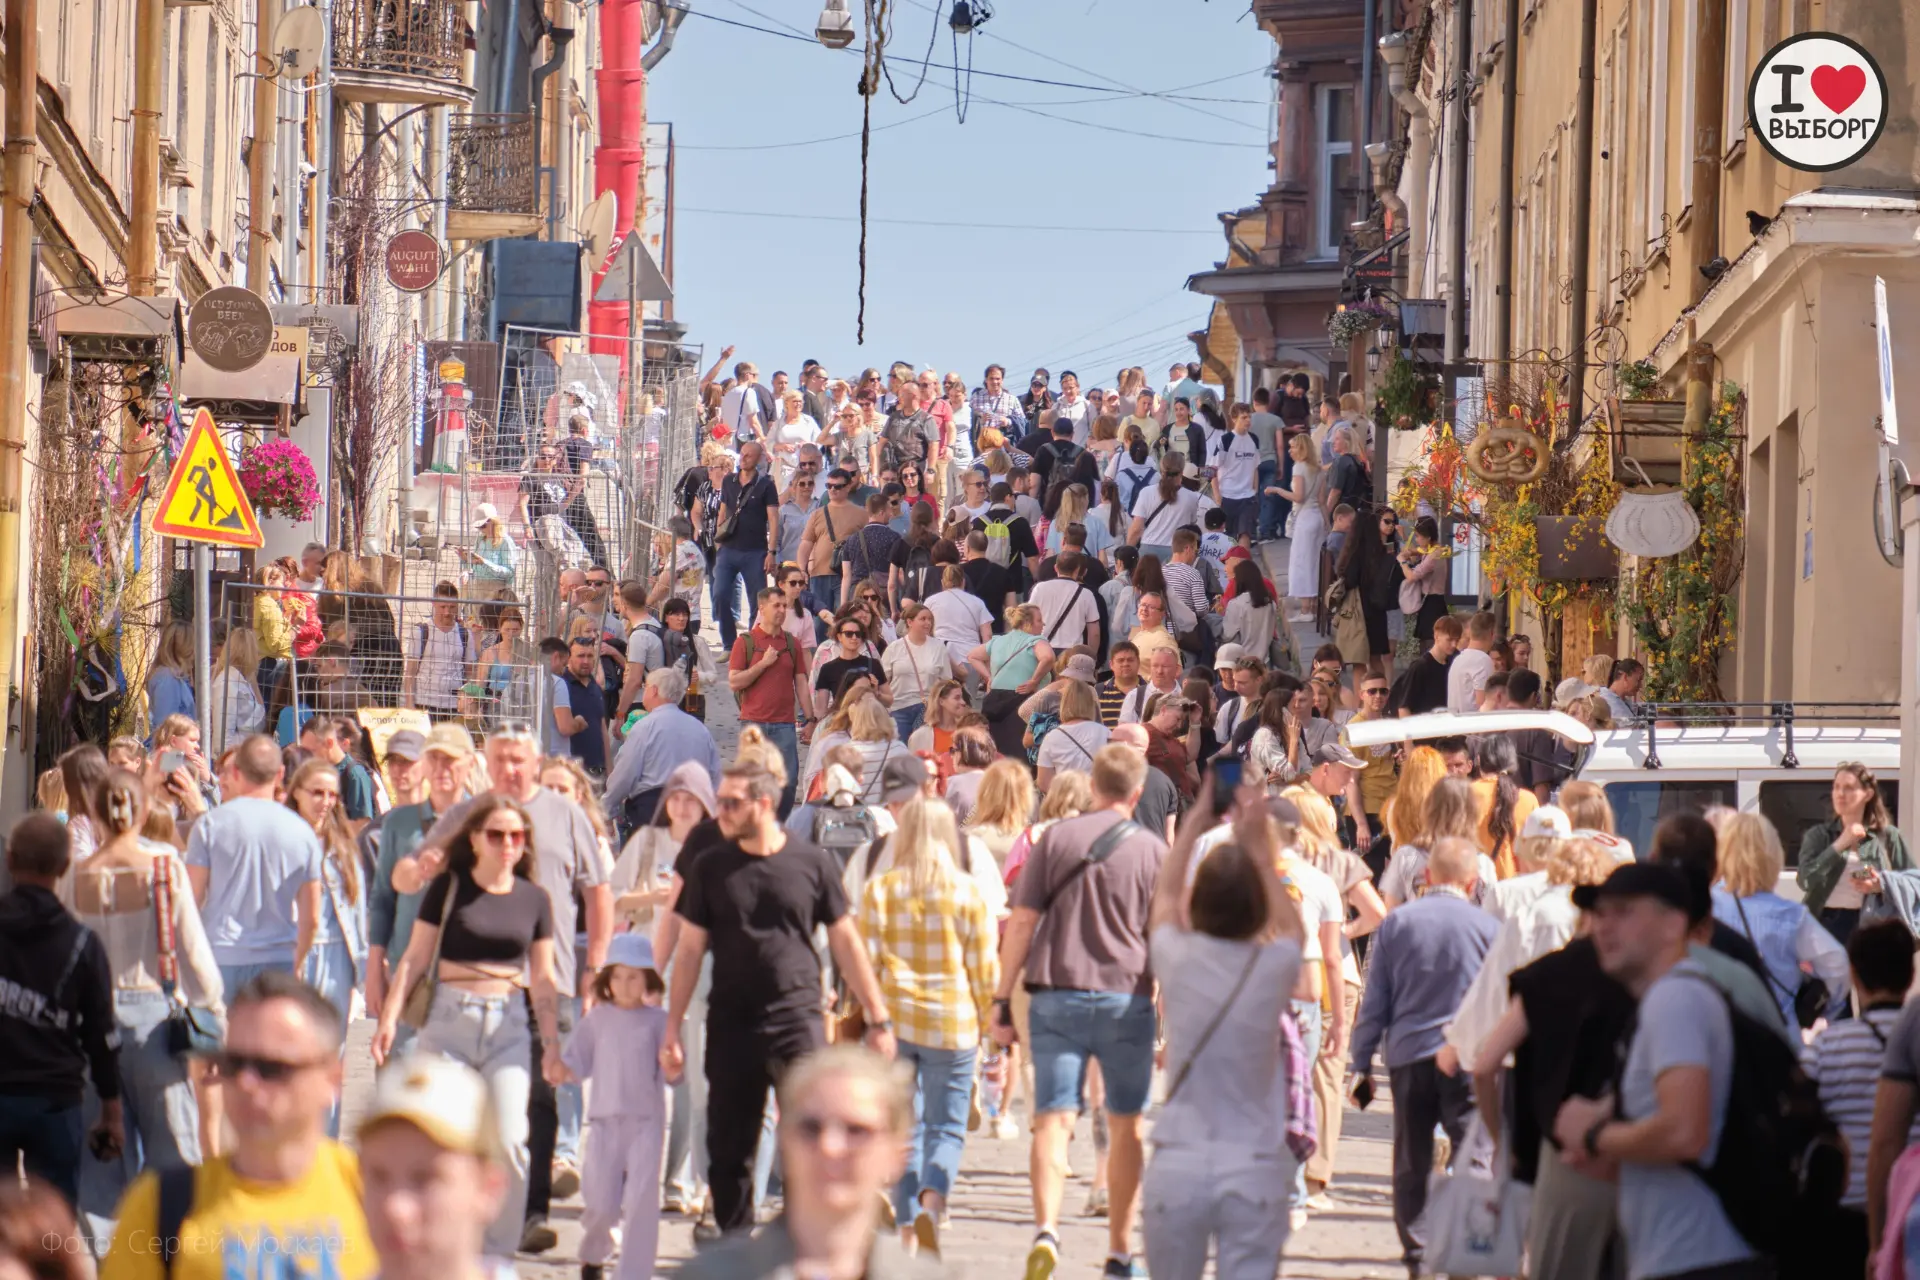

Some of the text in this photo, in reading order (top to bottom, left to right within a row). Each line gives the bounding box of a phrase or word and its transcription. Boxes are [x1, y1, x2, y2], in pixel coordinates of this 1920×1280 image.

[390, 250, 436, 261] AUGUST
[395, 263, 431, 273] WAHL
[204, 299, 225, 309] OLD
[217, 310, 245, 321] BEER
[270, 342, 297, 353] ДОВ
